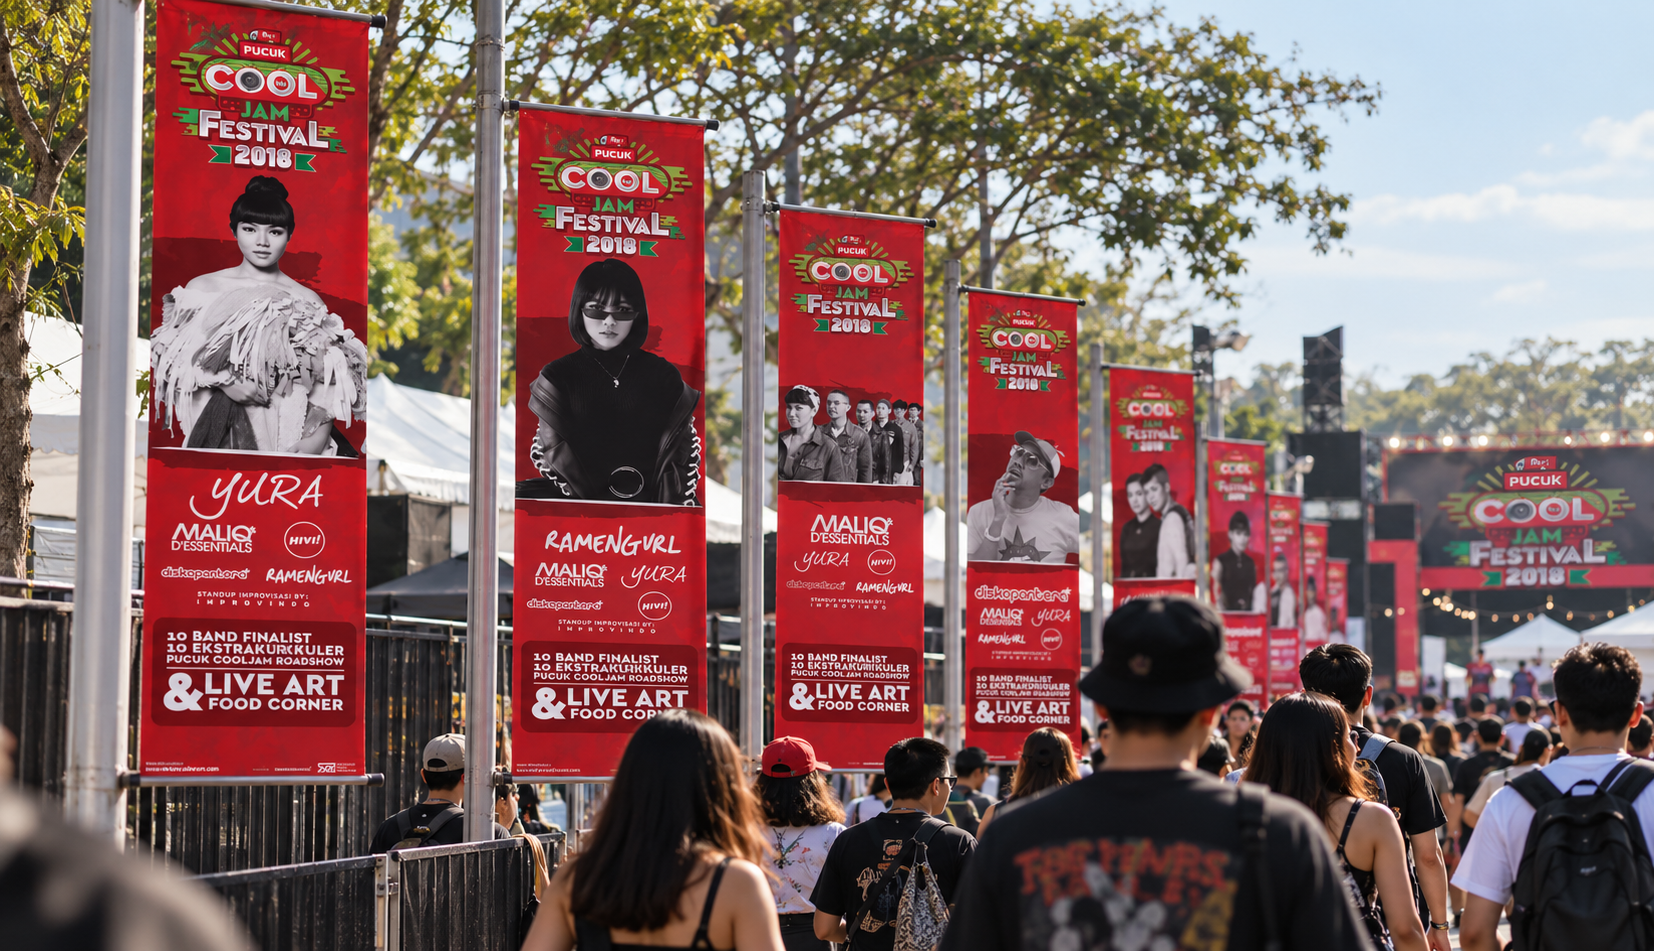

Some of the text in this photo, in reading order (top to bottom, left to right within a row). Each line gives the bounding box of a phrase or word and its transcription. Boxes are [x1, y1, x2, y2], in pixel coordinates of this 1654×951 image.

[244, 46, 286, 59] PUCUK
[205, 64, 318, 100] COOL
[240, 101, 289, 122] JAM
[199, 109, 329, 149] FESTIVAL
[234, 145, 292, 169] 2018
[595, 149, 632, 160] PUCUK
[561, 166, 659, 194] COOL
[592, 196, 634, 214] JAM
[555, 205, 670, 237] FESTIVAL
[586, 235, 637, 255] 2018
[838, 246, 867, 256] PUCUK
[811, 261, 888, 284] COOL
[835, 286, 869, 300] JAM
[807, 294, 896, 318] FESTIVAL
[831, 317, 871, 334] 2018
[992, 330, 1052, 349] COOL
[1011, 351, 1037, 362] JAM
[989, 357, 1058, 378] FESTIVAL
[1127, 402, 1174, 417] COOL
[1125, 425, 1180, 440] FESTIVAL
[1509, 475, 1562, 488] PUCUK
[189, 472, 323, 520] YURA
[1474, 497, 1594, 524] COOL
[289, 535, 321, 546] HIVI!
[1511, 528, 1562, 545] JAM
[1469, 538, 1606, 567] FESTIVAL
[794, 551, 850, 573] YURA
[620, 565, 687, 589] YURA
[1505, 567, 1566, 586] 2018
[197, 591, 236, 599] STANDUP
[642, 601, 668, 611] HIVI!
[1031, 608, 1071, 627] YURA
[167, 631, 312, 644] 10 BAND FINALIST
[167, 643, 188, 654] 10
[166, 654, 345, 666] PUCUK COOLJAM ROADSHOW
[533, 652, 660, 664] 10 BAND FINALIST
[791, 653, 888, 663] 10 BAND FINALIST
[533, 663, 551, 671] 10
[533, 672, 688, 683] PUCUK COOLJAM ROADSHOW
[163, 672, 345, 712] & LIVE ART
[789, 682, 910, 711] & LIVE ART
[208, 697, 344, 711] FOOD CORNER
[531, 687, 689, 720] & LIVE ART
[818, 700, 910, 712] FOOD CORNER
[974, 700, 1071, 724] & LIVE ART
[570, 708, 617, 720] FOOD
[997, 715, 1071, 725] FOOD CORNER
